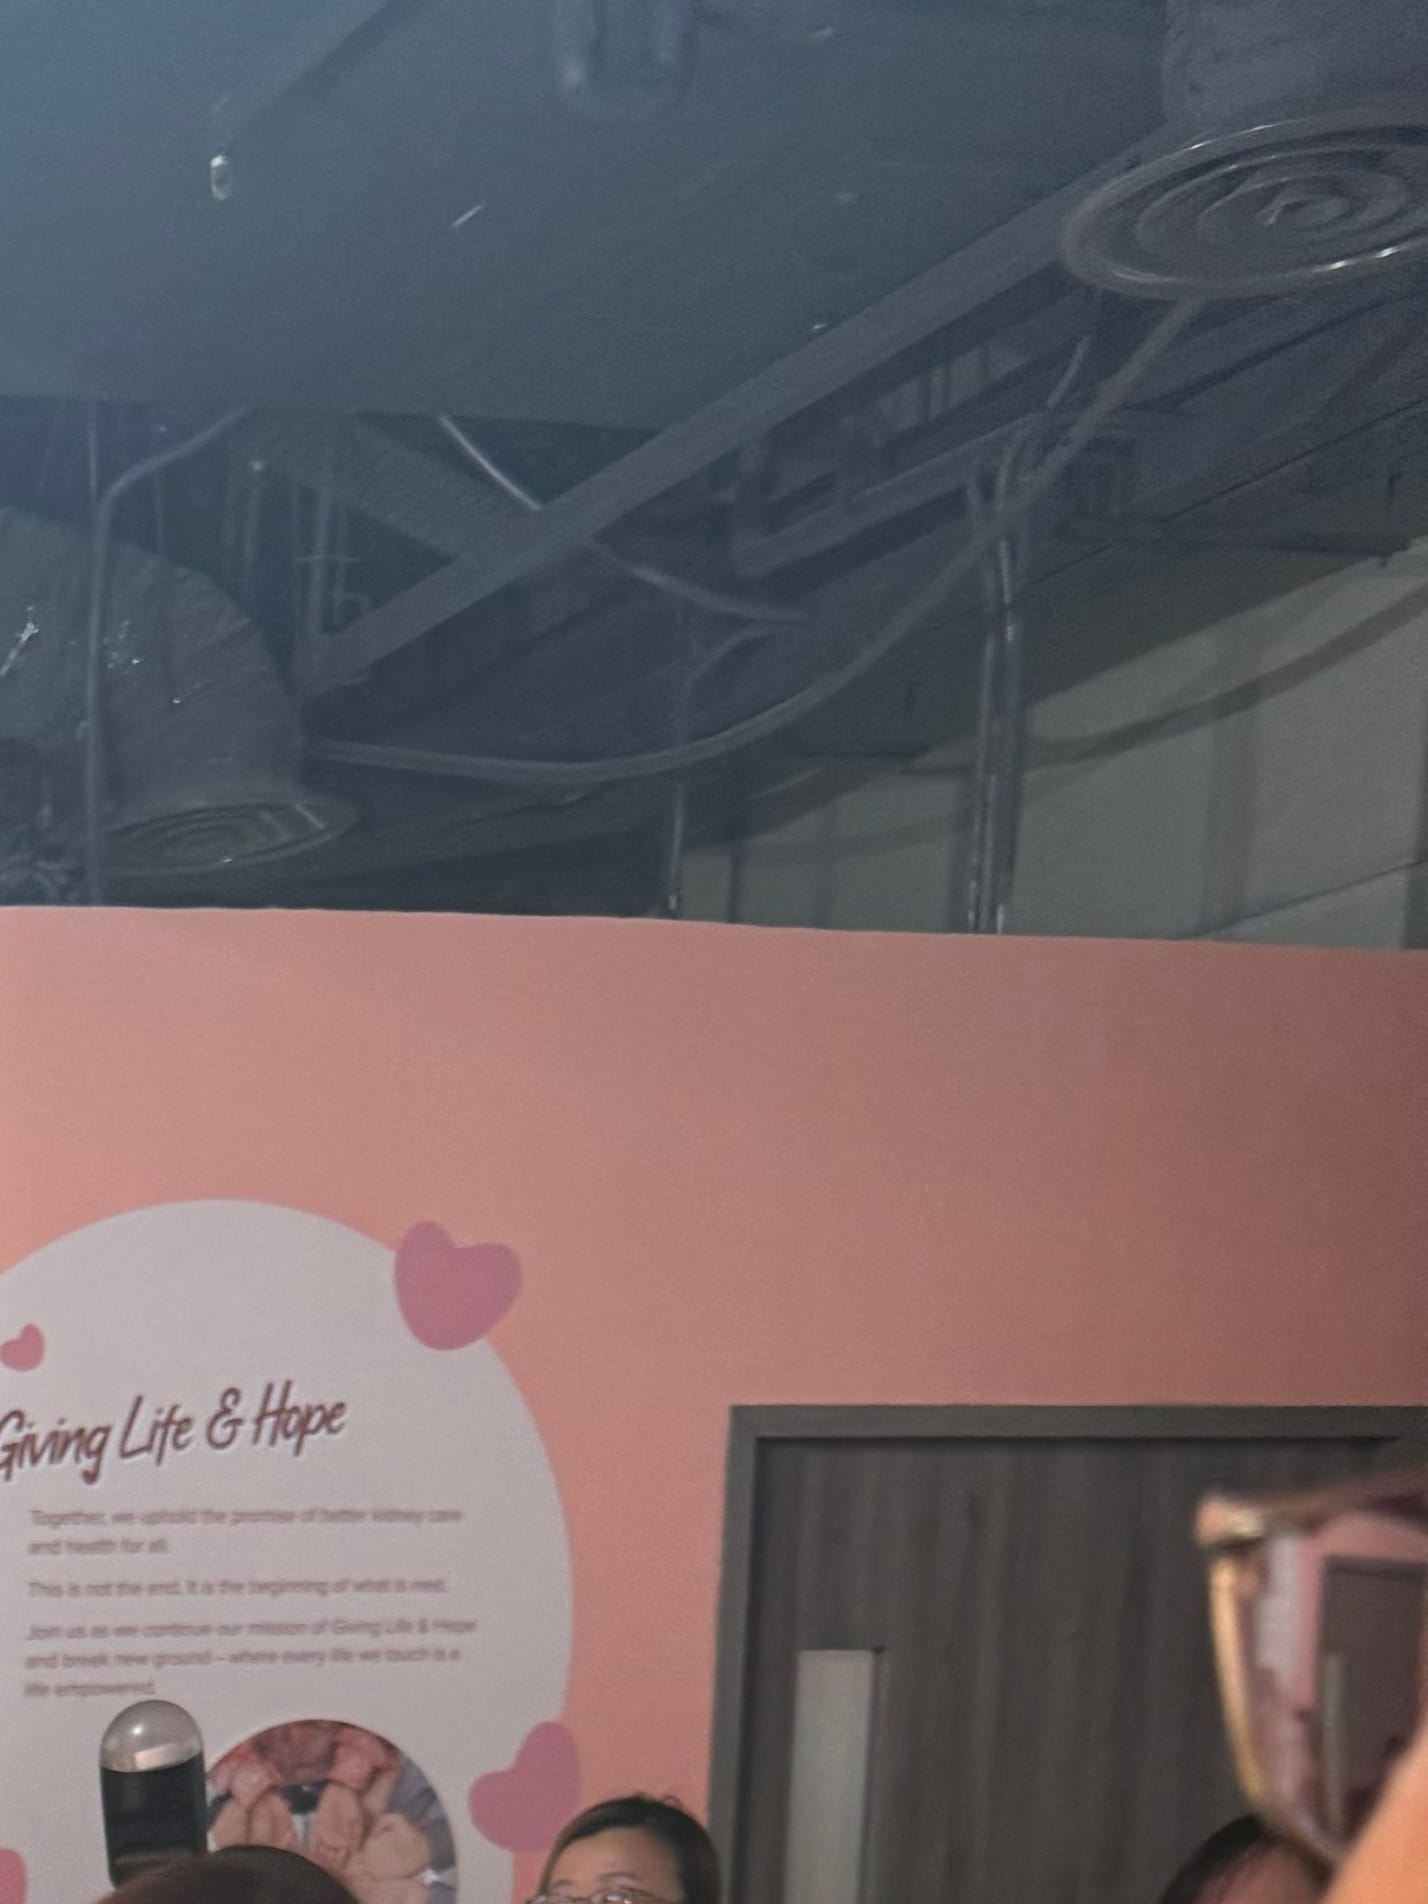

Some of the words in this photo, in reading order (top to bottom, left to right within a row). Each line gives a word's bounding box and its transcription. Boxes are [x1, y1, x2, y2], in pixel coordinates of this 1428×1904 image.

[119, 1394, 194, 1467] Life
[205, 1386, 245, 1450] &
[251, 1378, 348, 1458] Hope
